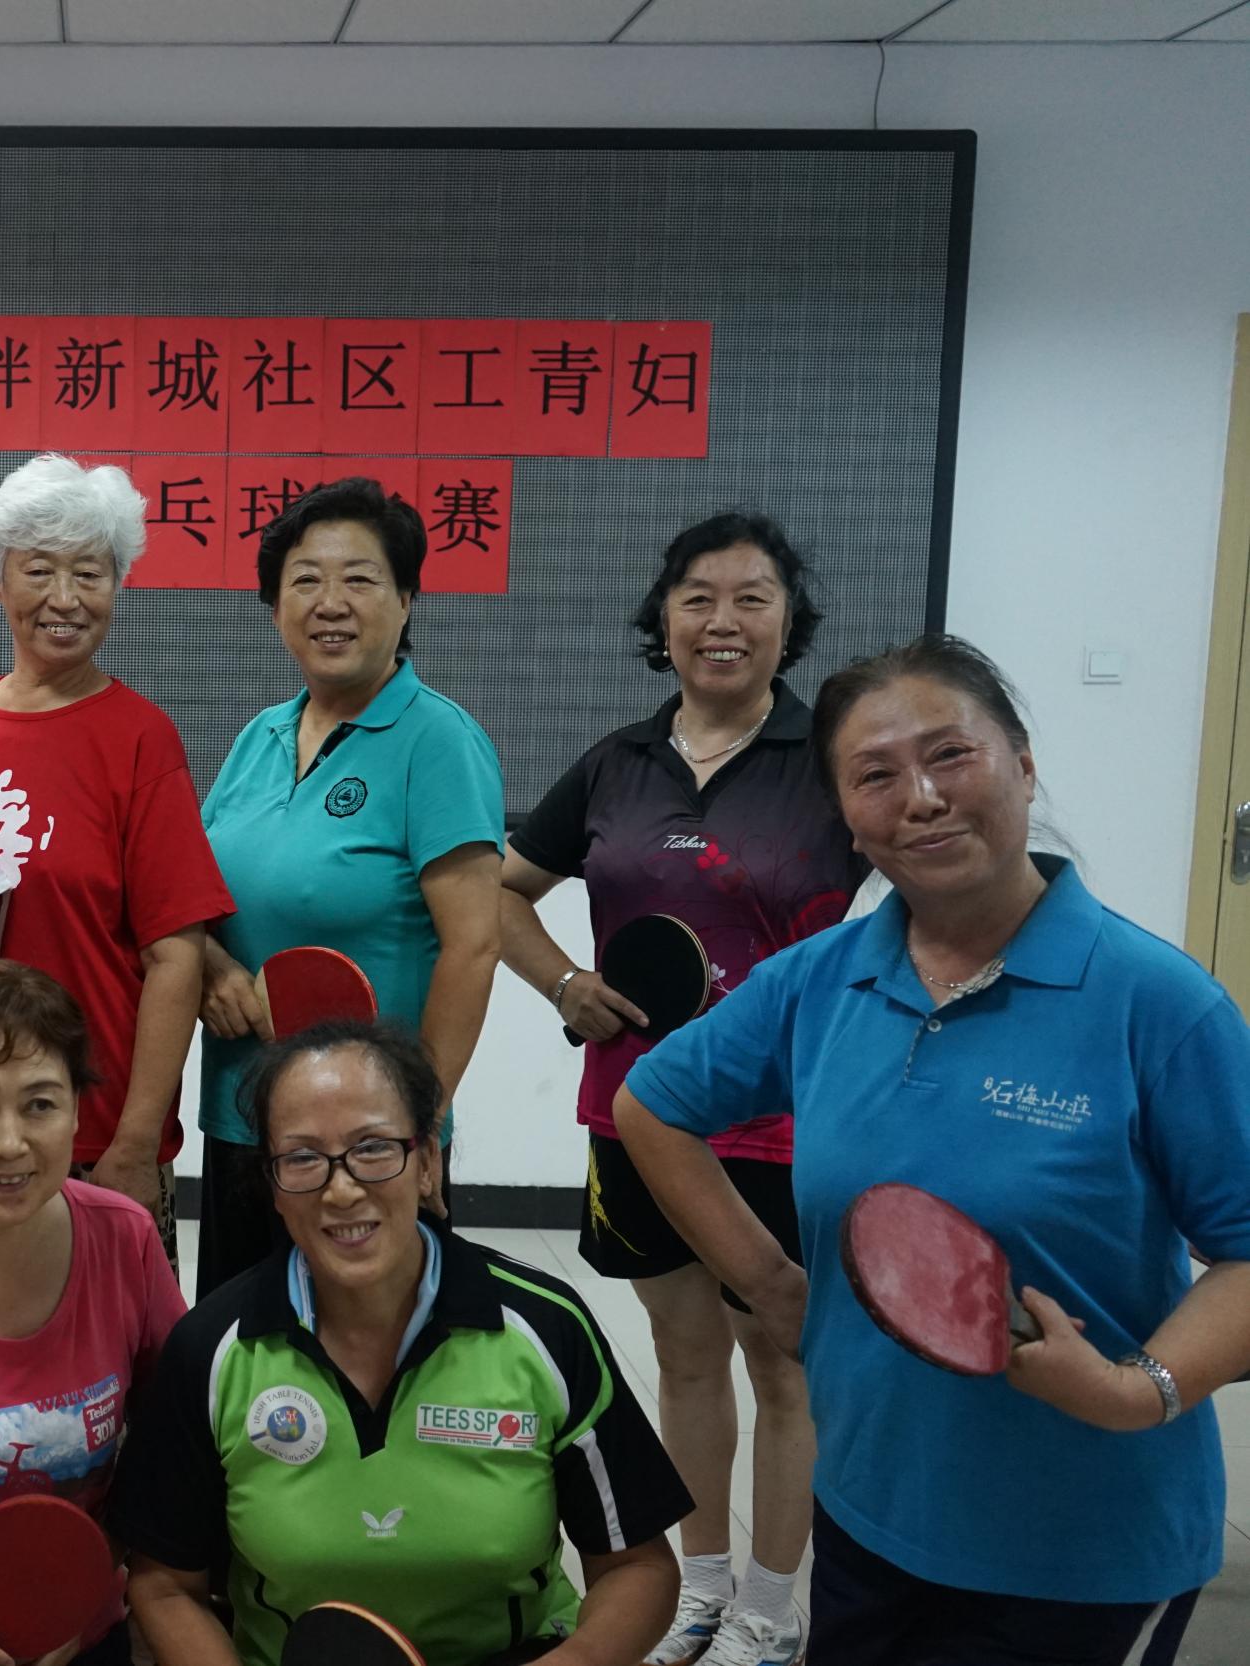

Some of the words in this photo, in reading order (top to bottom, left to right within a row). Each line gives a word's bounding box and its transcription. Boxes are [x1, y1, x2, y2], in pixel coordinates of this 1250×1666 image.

[145, 475, 502, 554] 乓球赛
[253, 1401, 266, 1424] IRISH
[266, 1389, 291, 1402] TABLE
[293, 1391, 320, 1419] TENNIS
